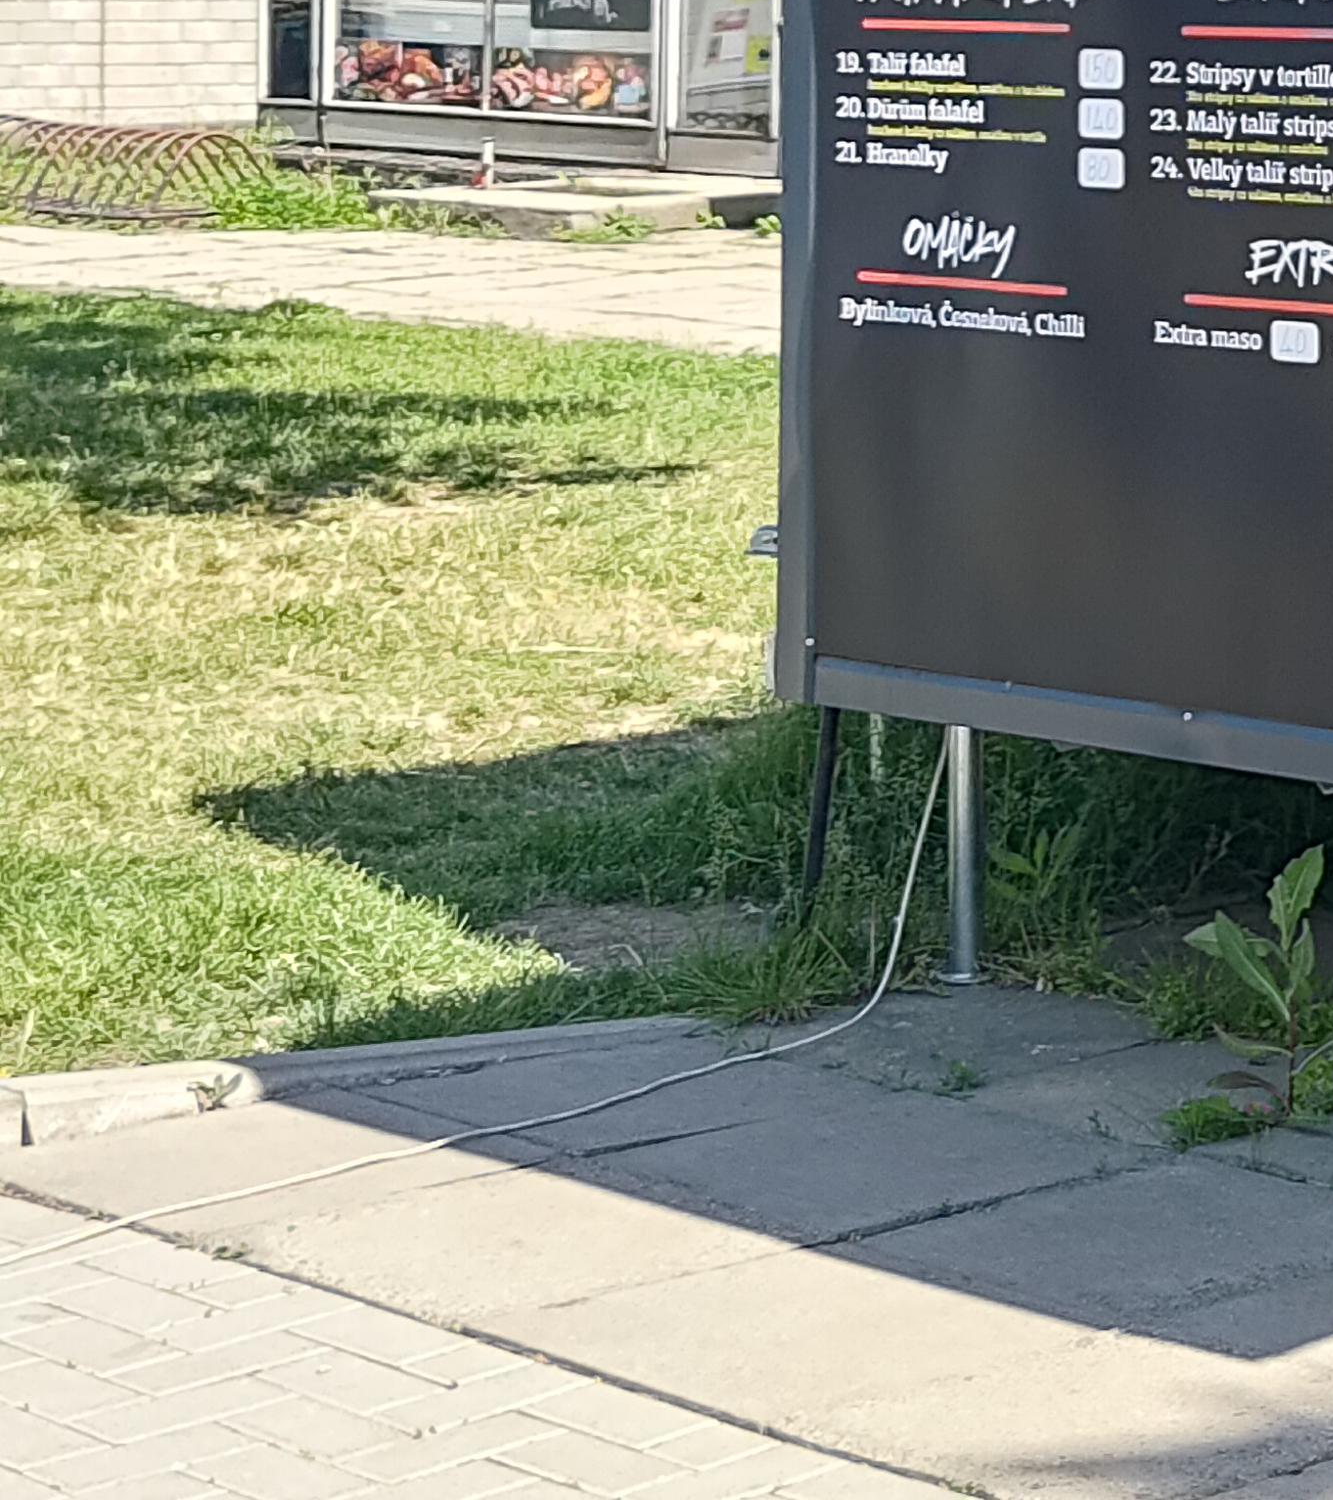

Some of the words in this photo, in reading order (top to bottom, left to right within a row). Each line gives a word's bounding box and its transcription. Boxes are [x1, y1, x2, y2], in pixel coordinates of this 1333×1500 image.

[1186, 62, 1257, 91] Stripsy
[1259, 69, 1274, 85] v
[836, 96, 865, 118] 20.
[1150, 109, 1182, 131] 23.
[1185, 110, 1237, 138] Malý
[1240, 112, 1280, 134] talíř
[1150, 157, 1183, 179] 24.
[1187, 157, 1242, 186] Velký
[1246, 161, 1285, 183] talíř
[1034, 313, 1085, 338] Chilli
[1154, 321, 1208, 346] Extra
[1210, 329, 1263, 351] maso
